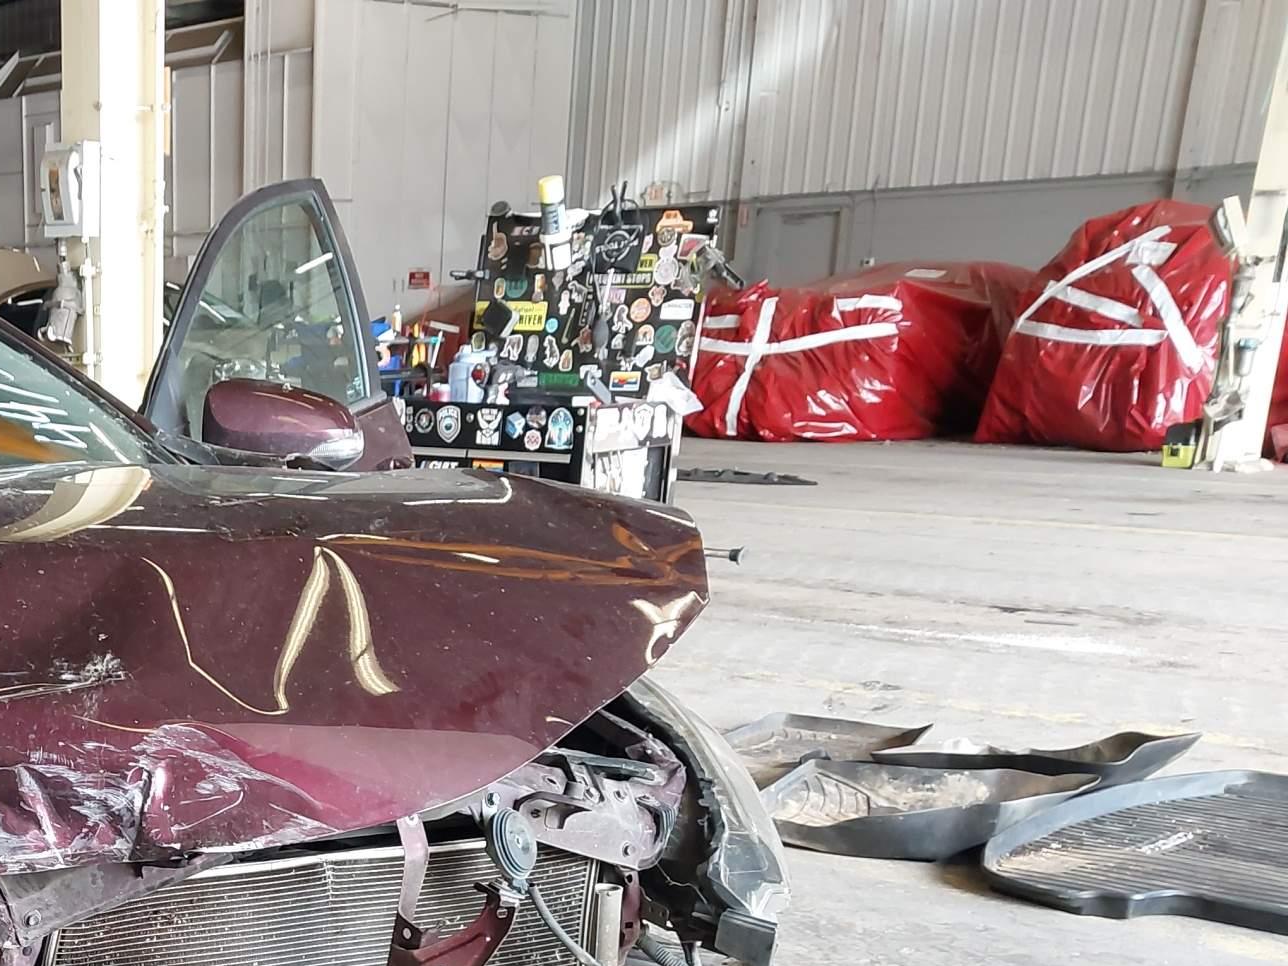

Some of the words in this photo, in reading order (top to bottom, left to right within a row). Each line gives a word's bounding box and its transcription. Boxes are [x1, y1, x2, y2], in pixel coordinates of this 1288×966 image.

[639, 259, 654, 268] VER
[589, 273, 626, 284] FREQENT
[626, 273, 652, 284] STOPS
[518, 314, 544, 325] RIVER
[438, 407, 459, 419] POLICE
